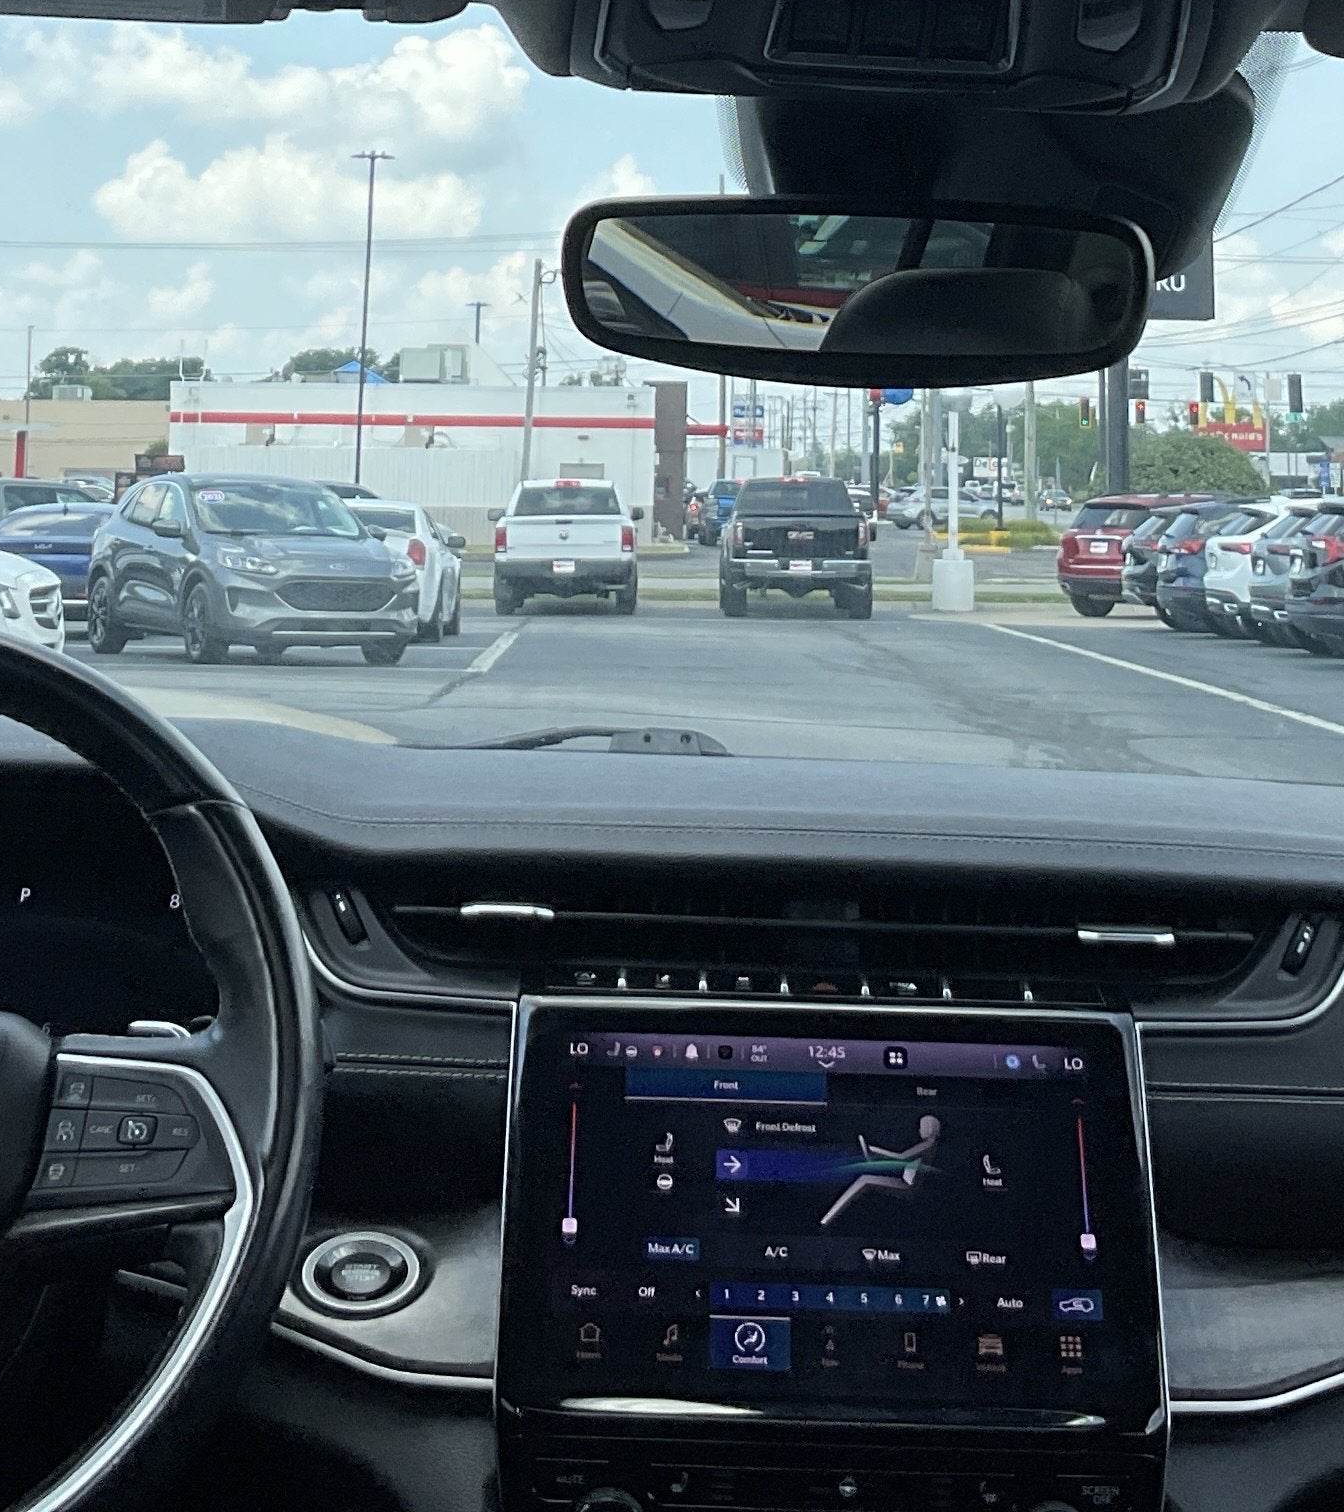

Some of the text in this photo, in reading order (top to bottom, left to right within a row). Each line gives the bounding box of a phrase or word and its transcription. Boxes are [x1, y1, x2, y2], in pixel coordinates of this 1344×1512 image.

[21, 888, 30, 903] P
[170, 894, 180, 909] 8
[569, 1042, 589, 1056] LO
[808, 1045, 846, 1059] 12:45
[1064, 1058, 1083, 1070] LO
[713, 1080, 739, 1090] Front
[756, 1121, 816, 1133] Front Defrost
[648, 1243, 694, 1255] Max A/C
[765, 1245, 788, 1257] A/C
[877, 1249, 900, 1261] Max
[982, 1252, 1006, 1264] Rear
[571, 1285, 597, 1298] Sync
[638, 1286, 655, 1298] Off
[724, 1289, 930, 1306] 1 2 3 4 5 6 7
[997, 1297, 1023, 1308] Auto
[732, 1355, 768, 1365] Comfort
